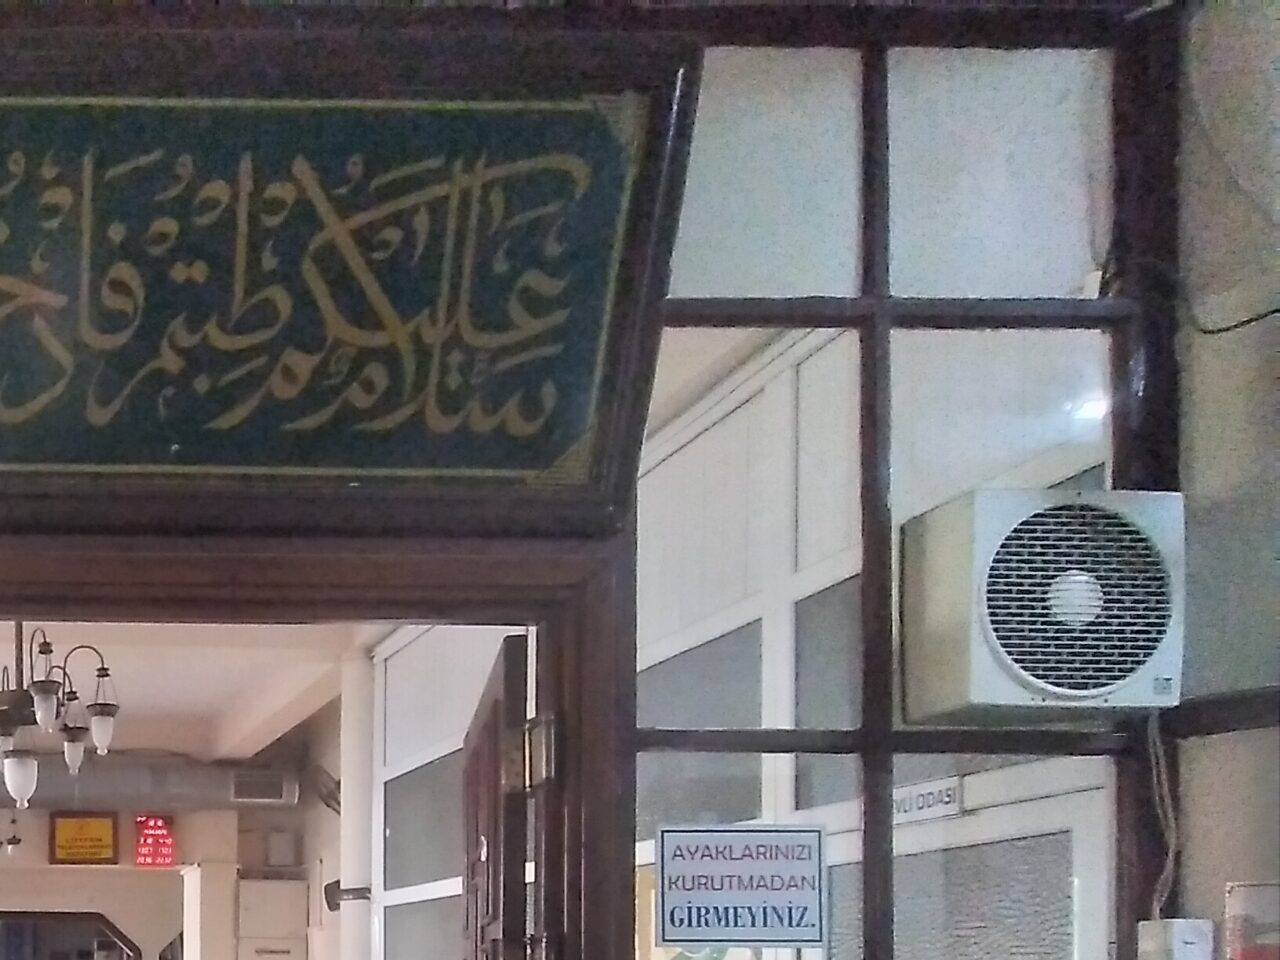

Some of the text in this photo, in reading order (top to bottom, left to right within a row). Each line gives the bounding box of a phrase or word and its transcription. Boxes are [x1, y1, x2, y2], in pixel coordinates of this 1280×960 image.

[671, 843, 813, 862] AYAKLARINIZI
[668, 874, 816, 892] KURUTMADAN
[669, 900, 817, 929] GİRMEYİNİZ.
